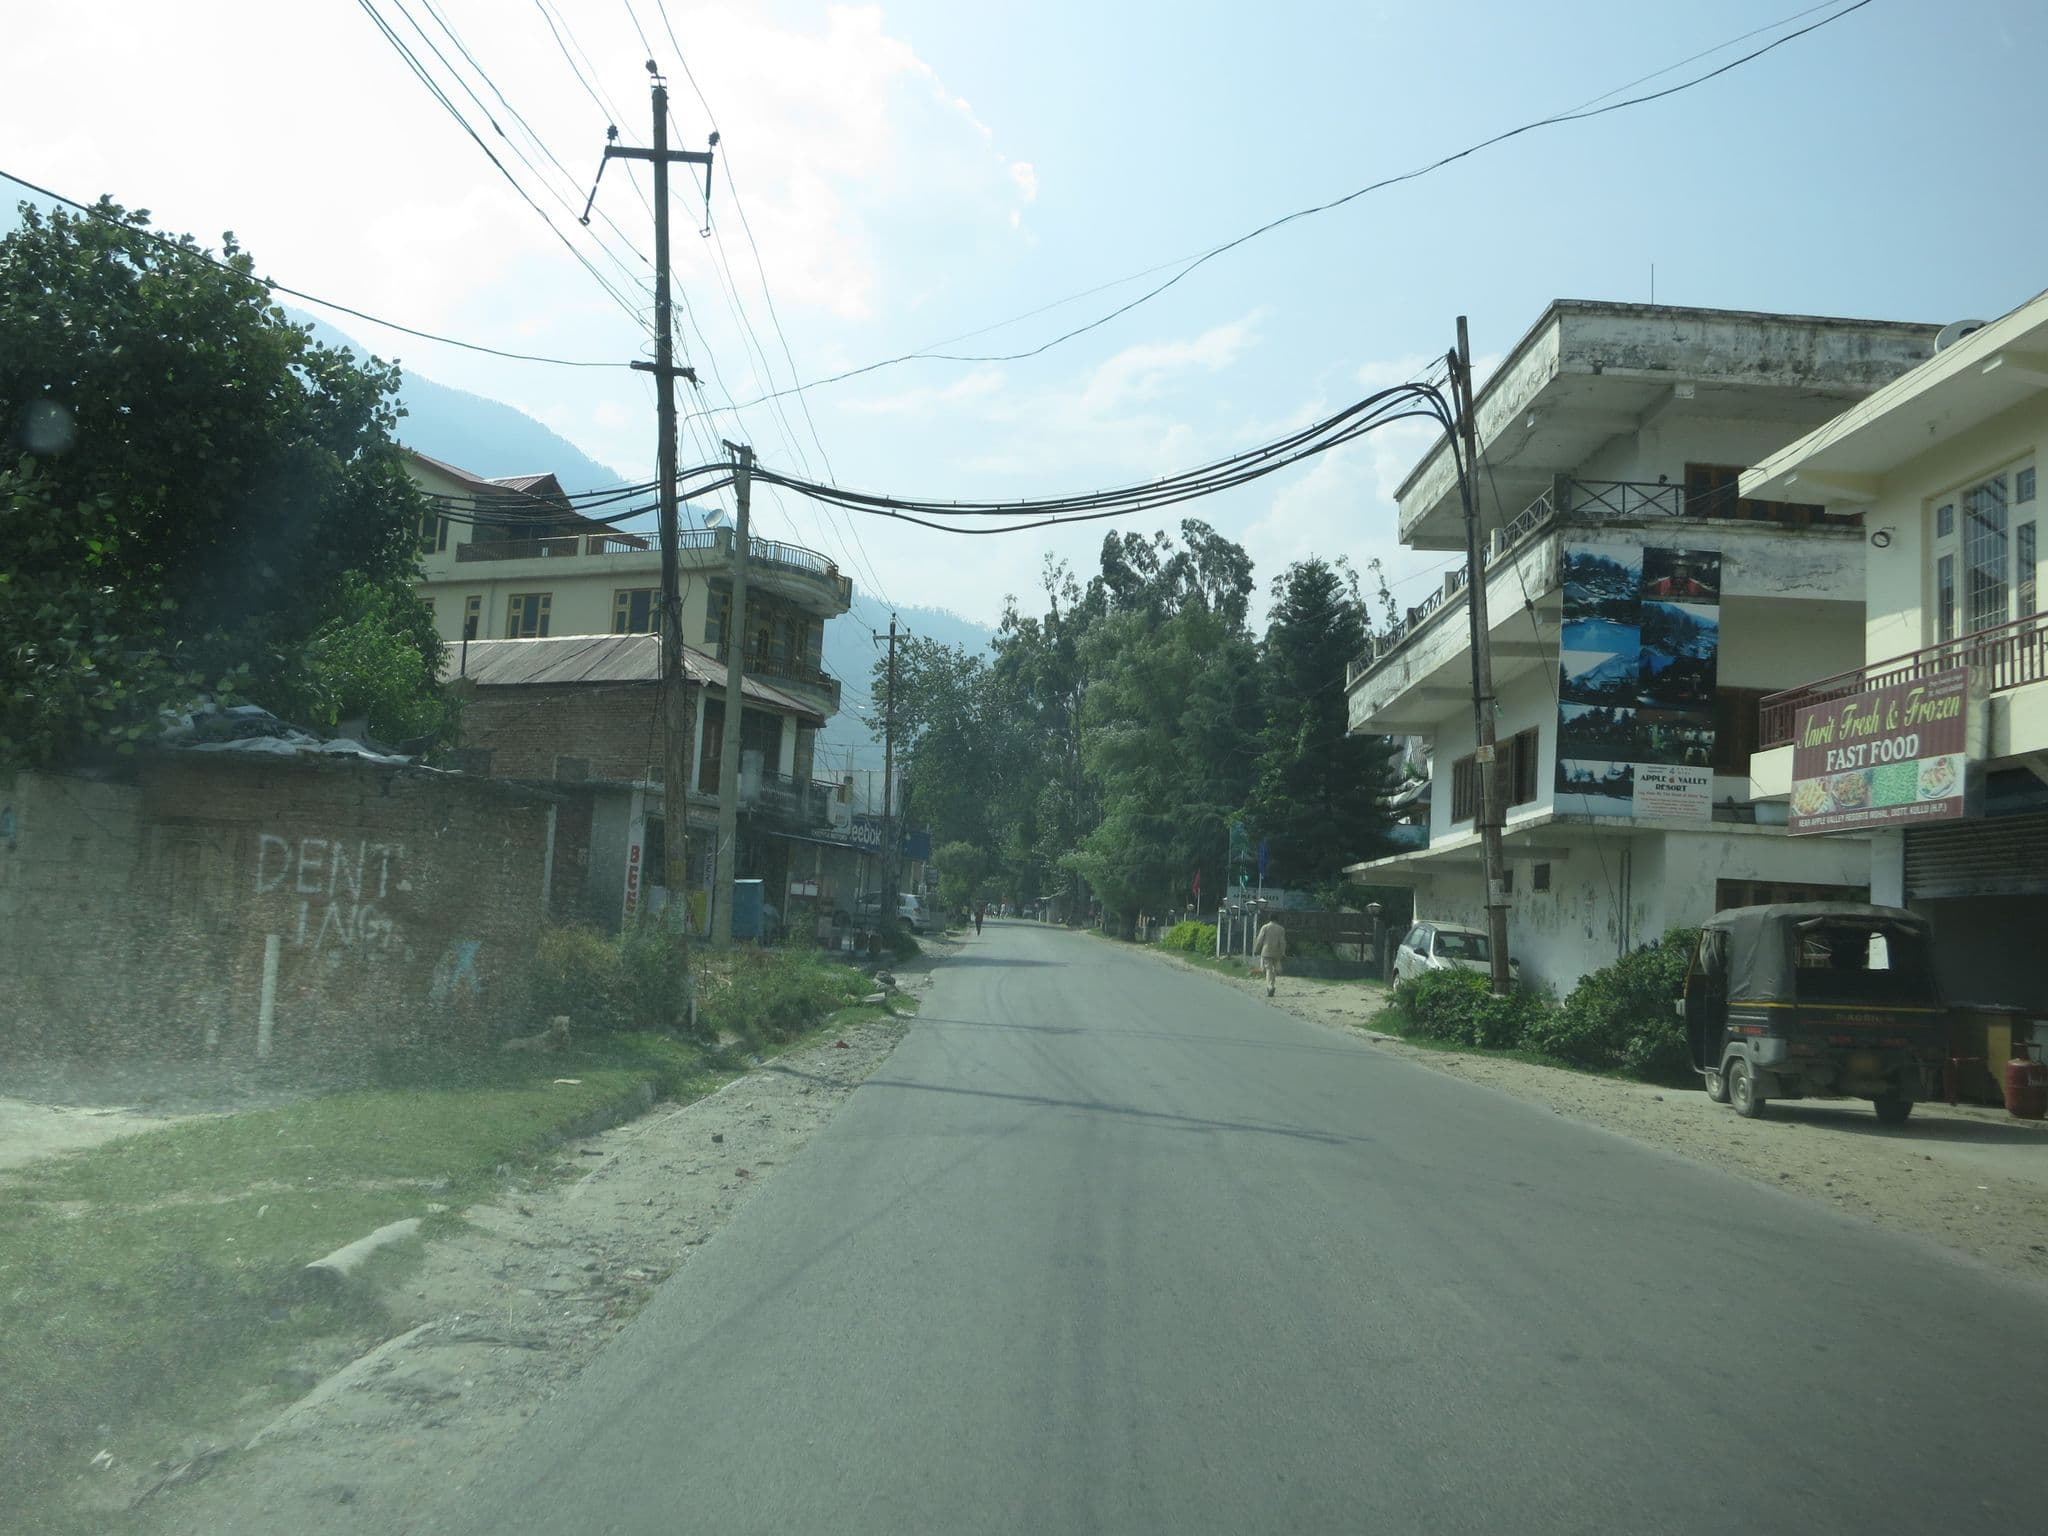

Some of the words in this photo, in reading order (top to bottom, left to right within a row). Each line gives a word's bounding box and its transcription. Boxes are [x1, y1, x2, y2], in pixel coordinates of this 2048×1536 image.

[1840, 697, 1880, 740] Fresh
[1886, 701, 1899, 730] &
[1904, 686, 1960, 727] Frozen
[1826, 744, 1867, 772] FAST
[1869, 733, 1919, 764] FOOD
[1640, 774, 1667, 783] APPLE
[1678, 776, 1707, 785] VALLEY
